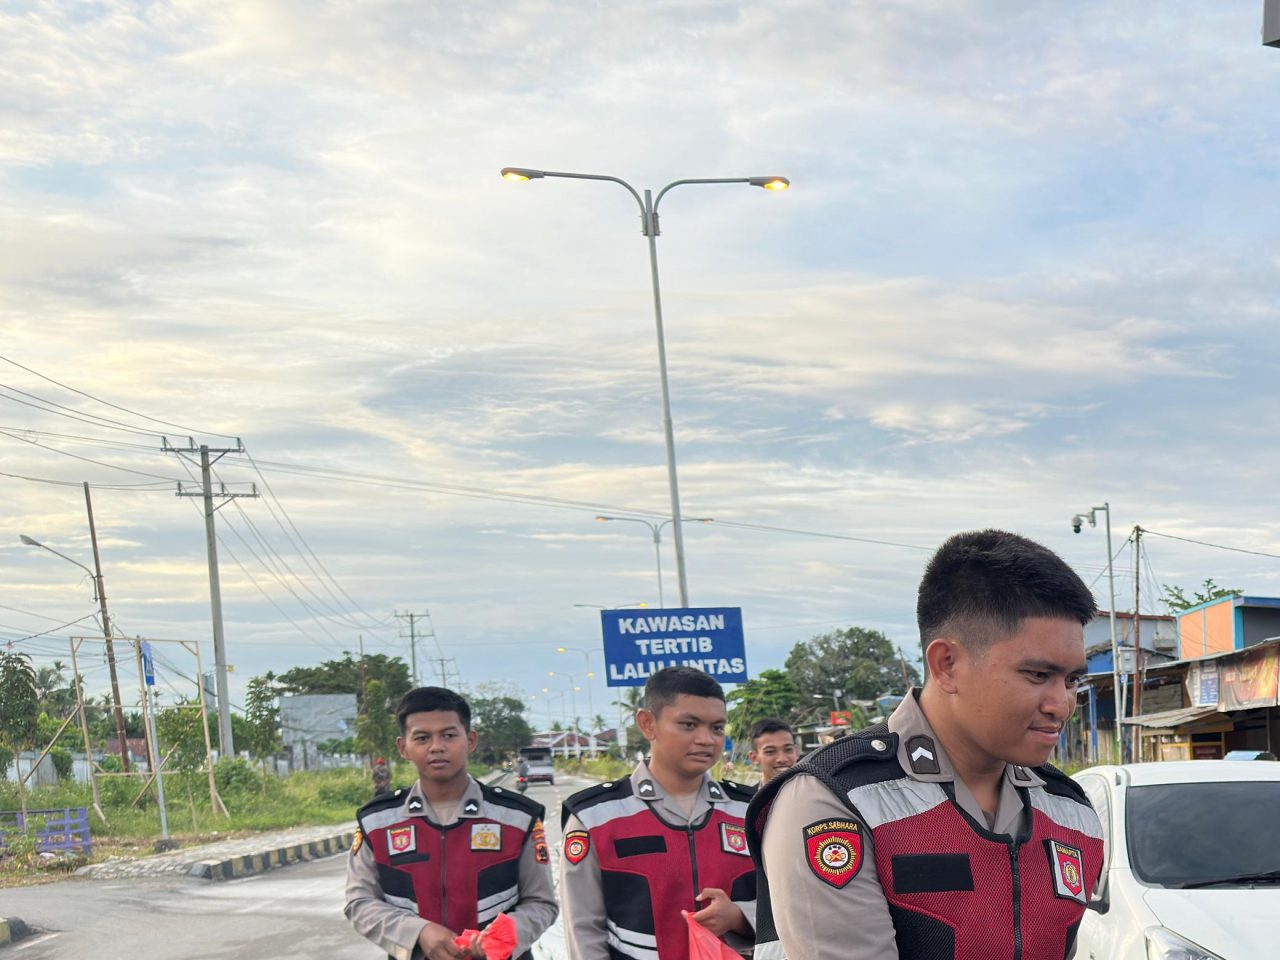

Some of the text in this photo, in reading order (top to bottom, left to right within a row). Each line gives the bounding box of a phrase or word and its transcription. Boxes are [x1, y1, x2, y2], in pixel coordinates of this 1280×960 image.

[618, 614, 725, 634] KAWASAN
[635, 637, 713, 655] TERTIB
[806, 820, 858, 836] KORPS SABHARA
